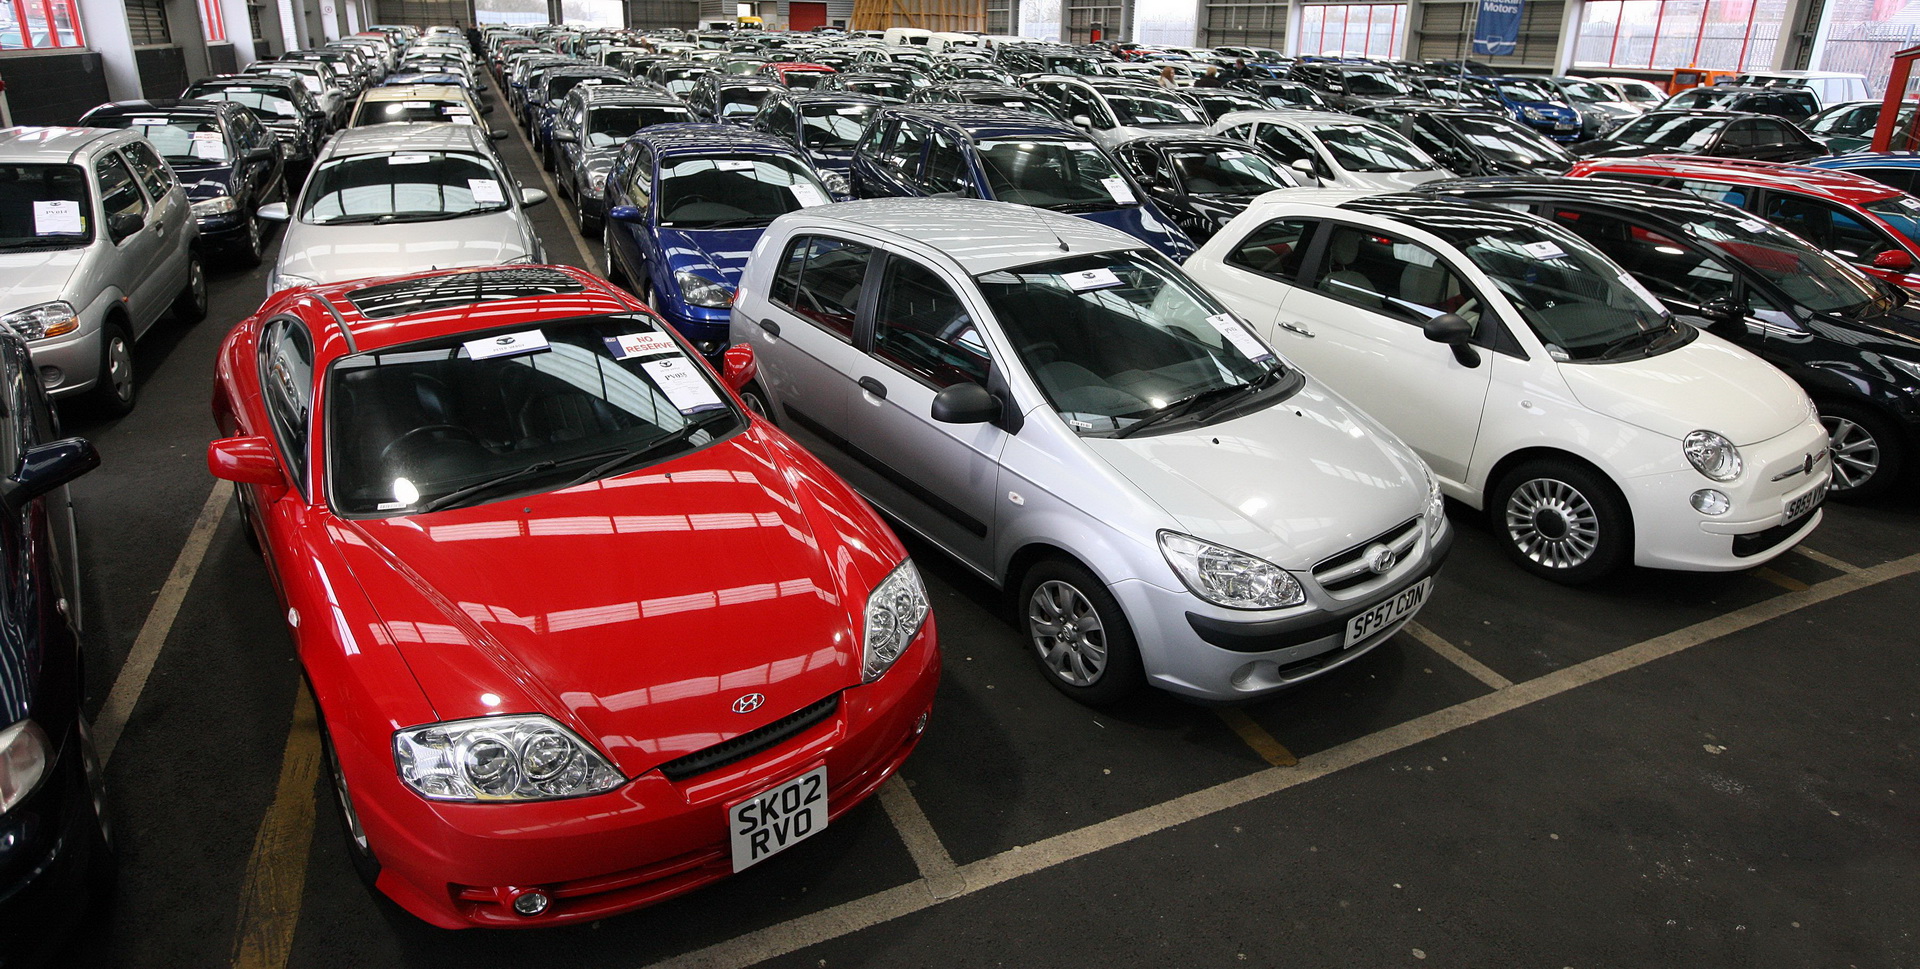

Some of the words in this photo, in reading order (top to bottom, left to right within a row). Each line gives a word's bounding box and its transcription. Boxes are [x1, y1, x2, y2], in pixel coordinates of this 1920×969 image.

[1483, 2, 1518, 14] Motors
[625, 341, 675, 353] RESERVE
[636, 335, 654, 343] NO
[1353, 599, 1395, 640] SP57
[1396, 582, 1425, 615] CDN
[738, 774, 821, 836] SK02
[750, 807, 812, 861] RVO
